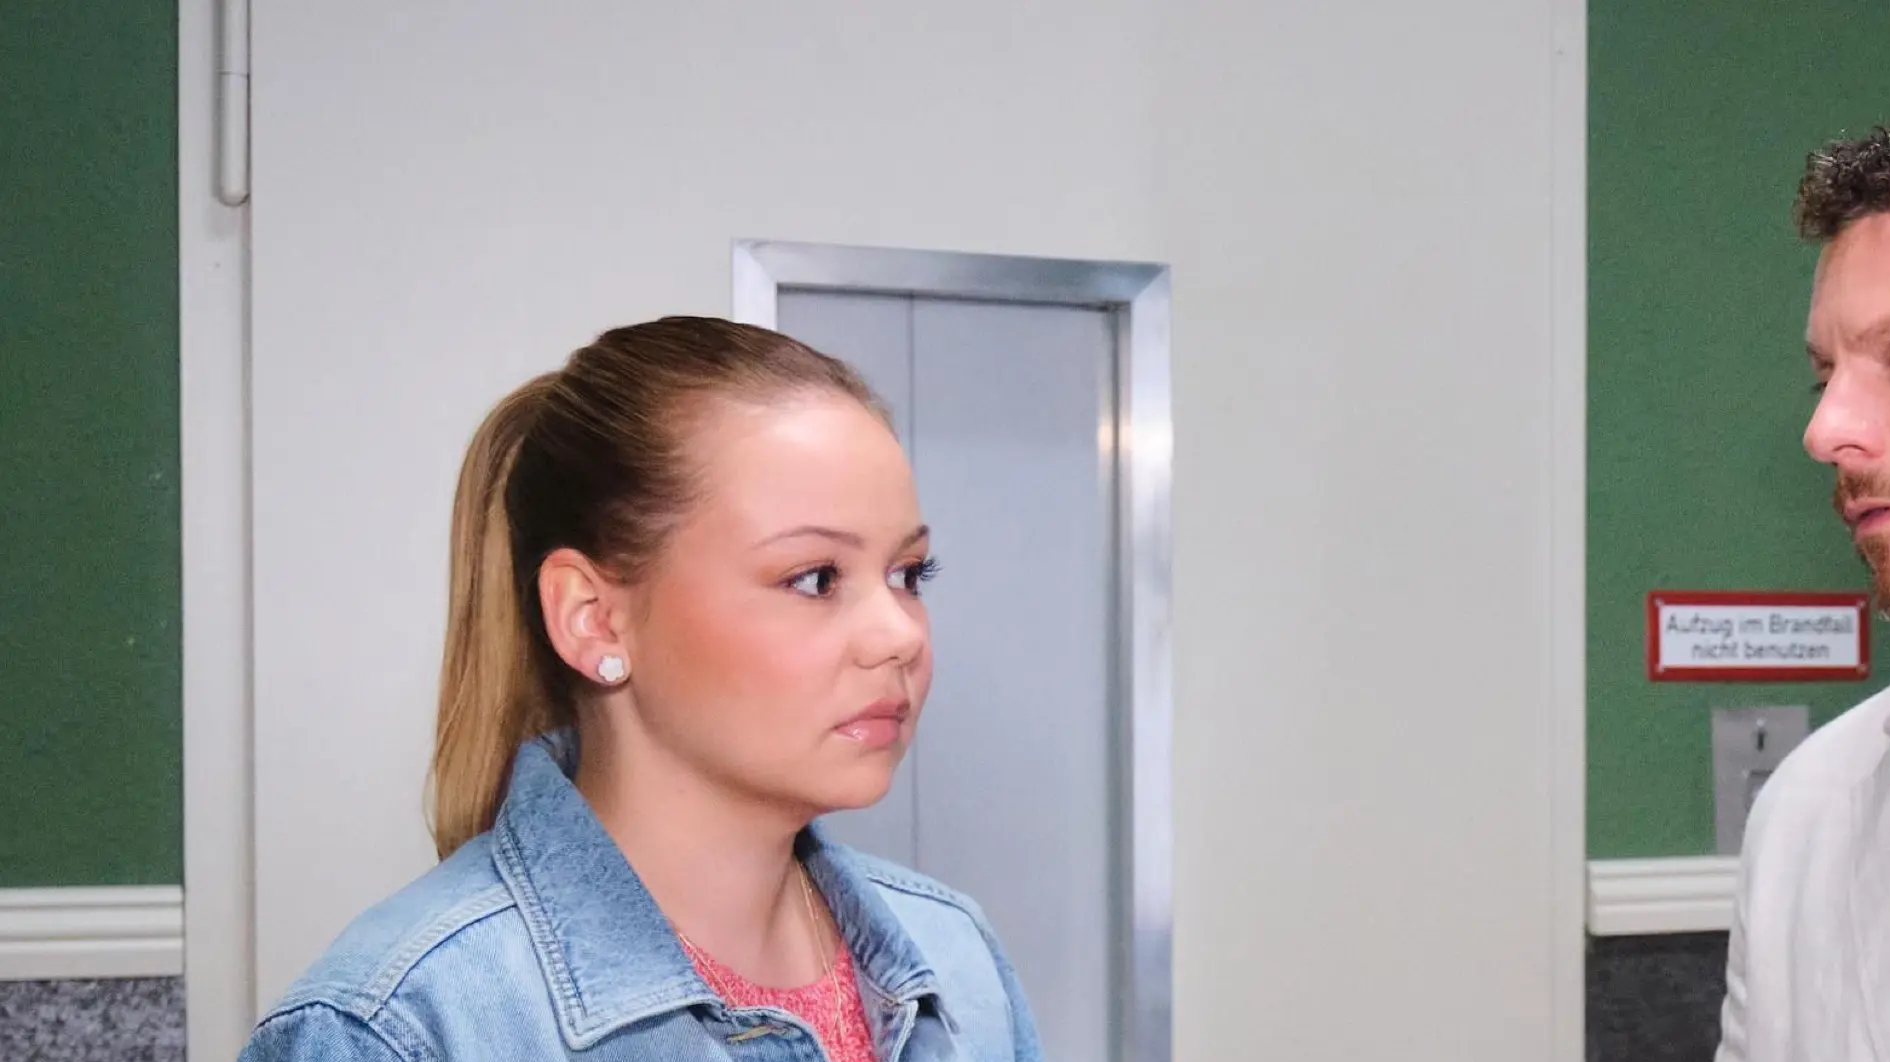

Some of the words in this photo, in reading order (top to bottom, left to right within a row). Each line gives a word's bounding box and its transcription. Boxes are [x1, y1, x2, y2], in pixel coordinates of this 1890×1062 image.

[1667, 613, 1733, 637] Aufzug
[1739, 613, 1763, 632] im
[1769, 612, 1853, 633] Brandfall
[1692, 641, 1738, 659] nicht
[1743, 641, 1829, 659] benutzen
